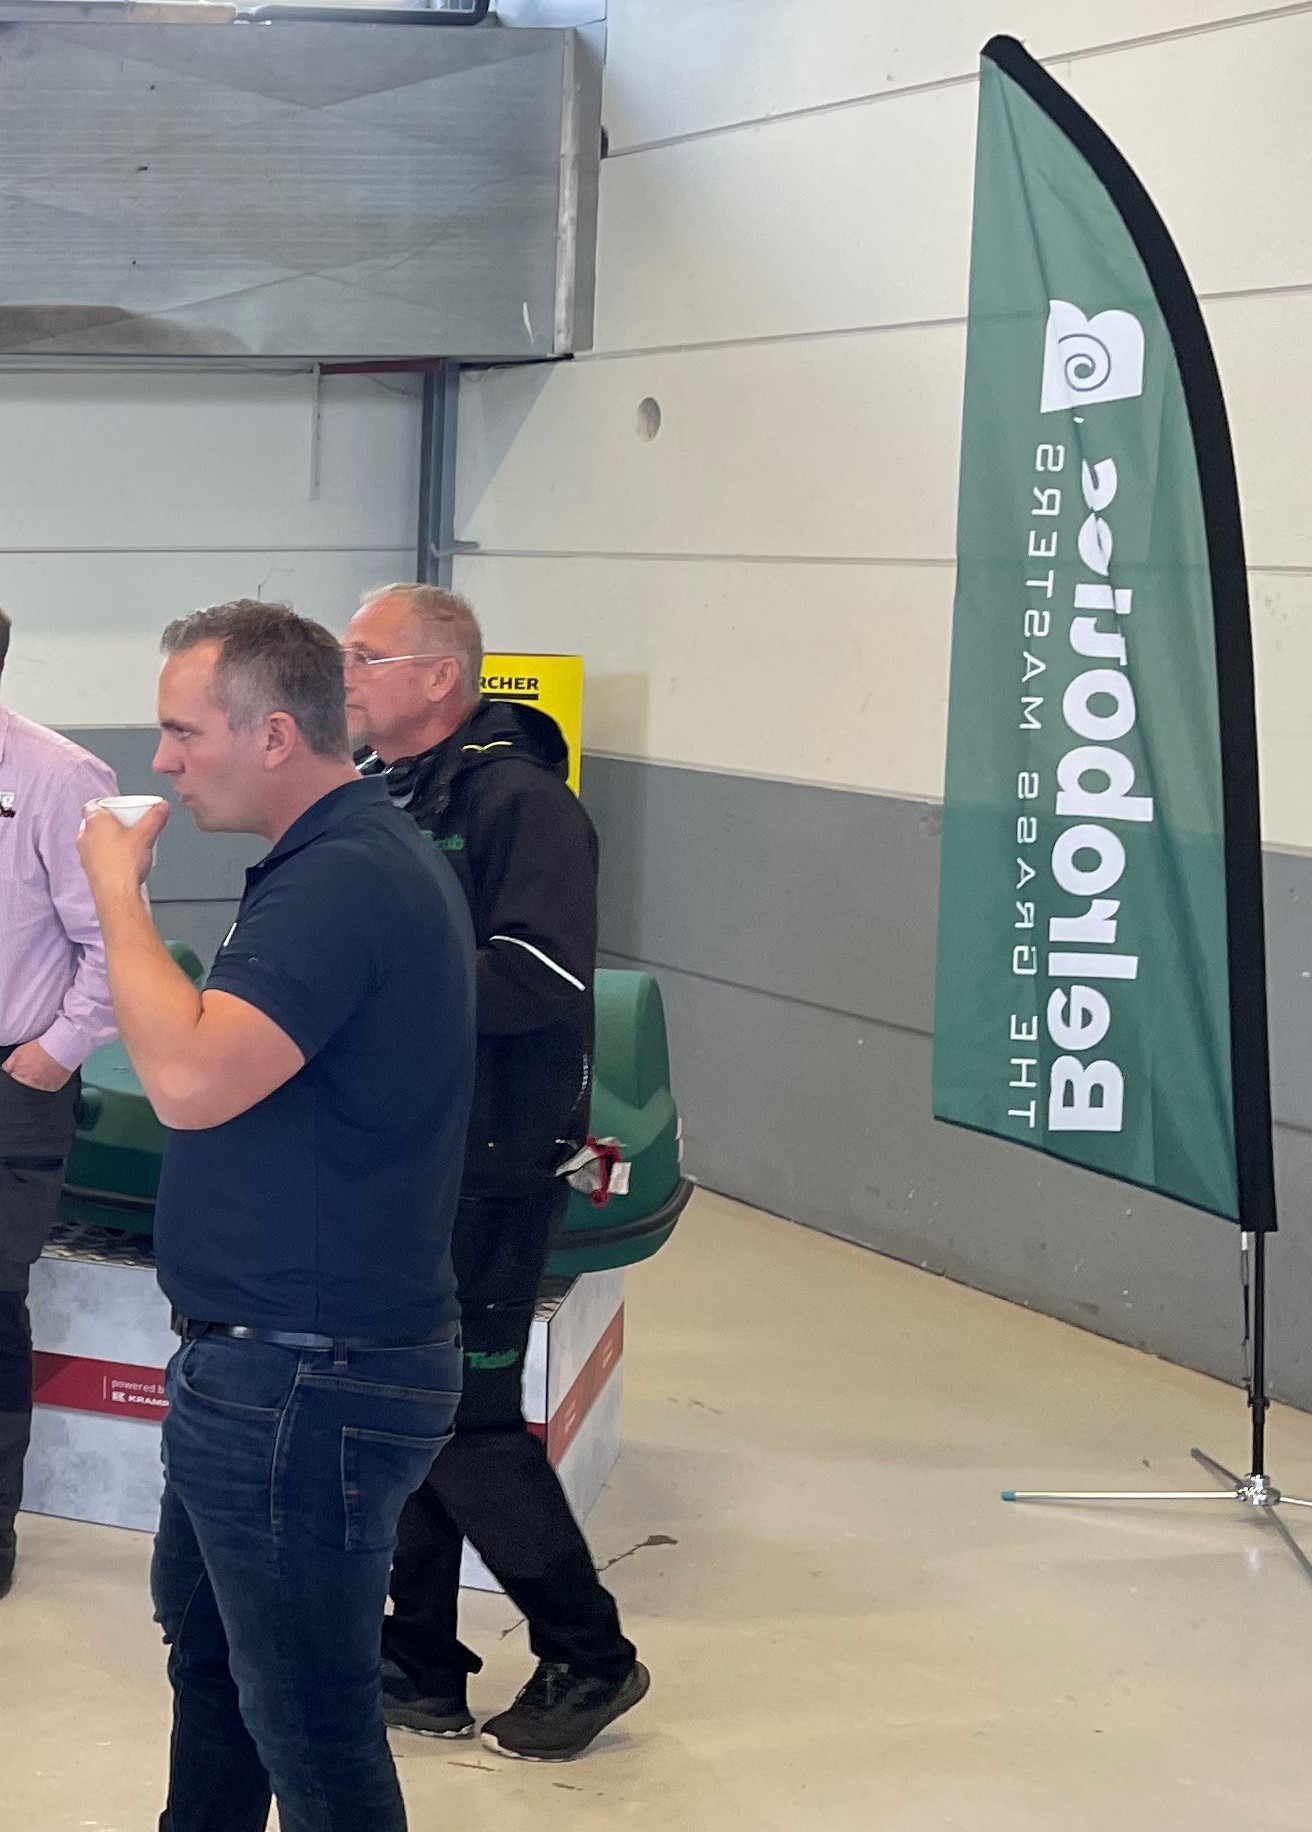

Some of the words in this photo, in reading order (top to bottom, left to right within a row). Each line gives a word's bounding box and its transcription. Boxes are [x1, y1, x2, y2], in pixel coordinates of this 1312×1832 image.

[479, 676, 539, 690] RCHER
[112, 1380, 155, 1393] powered
[158, 1385, 165, 1394] b
